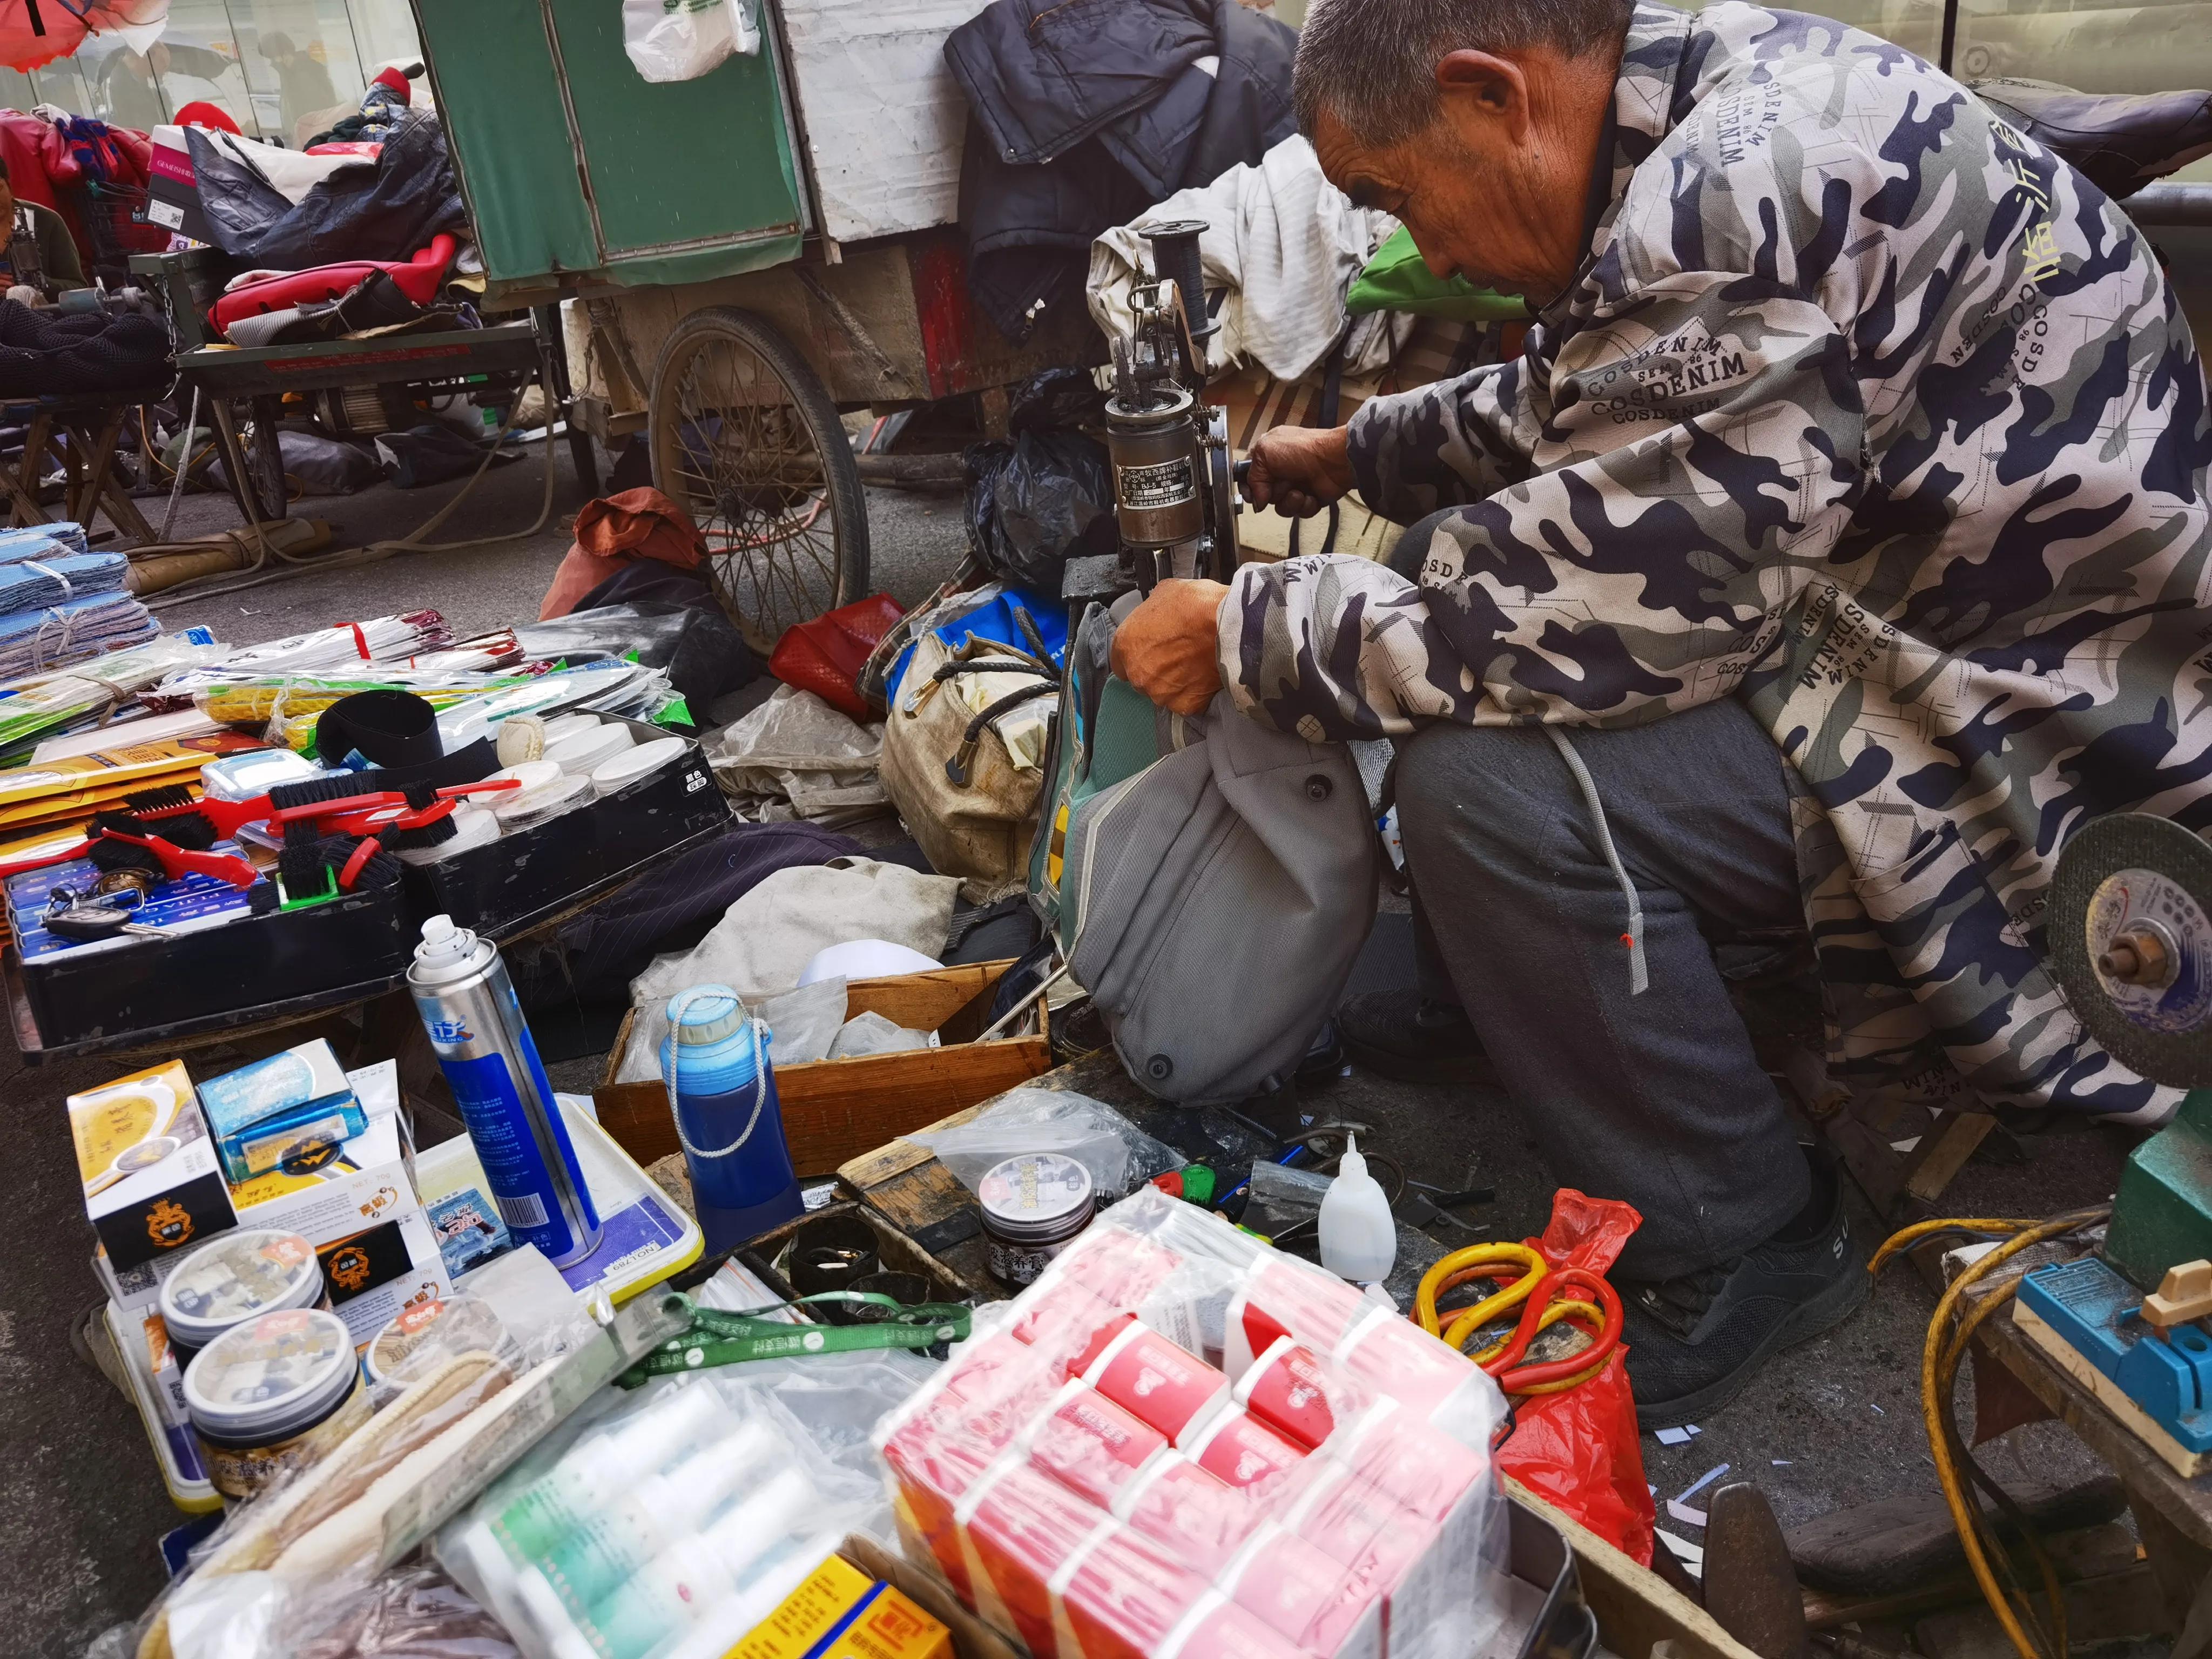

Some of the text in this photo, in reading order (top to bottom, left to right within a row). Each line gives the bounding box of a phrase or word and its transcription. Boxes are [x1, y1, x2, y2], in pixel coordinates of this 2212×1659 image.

[1588, 335, 1722, 397] COSDENIM
[1591, 352, 1748, 415] COSDENIM
[1612, 397, 1721, 424] COSDENIM
[685, 770, 702, 783] 黑色
[986, 1244, 1046, 1269] 皮滋养膏
[752, 1334, 801, 1355] 微信支付
